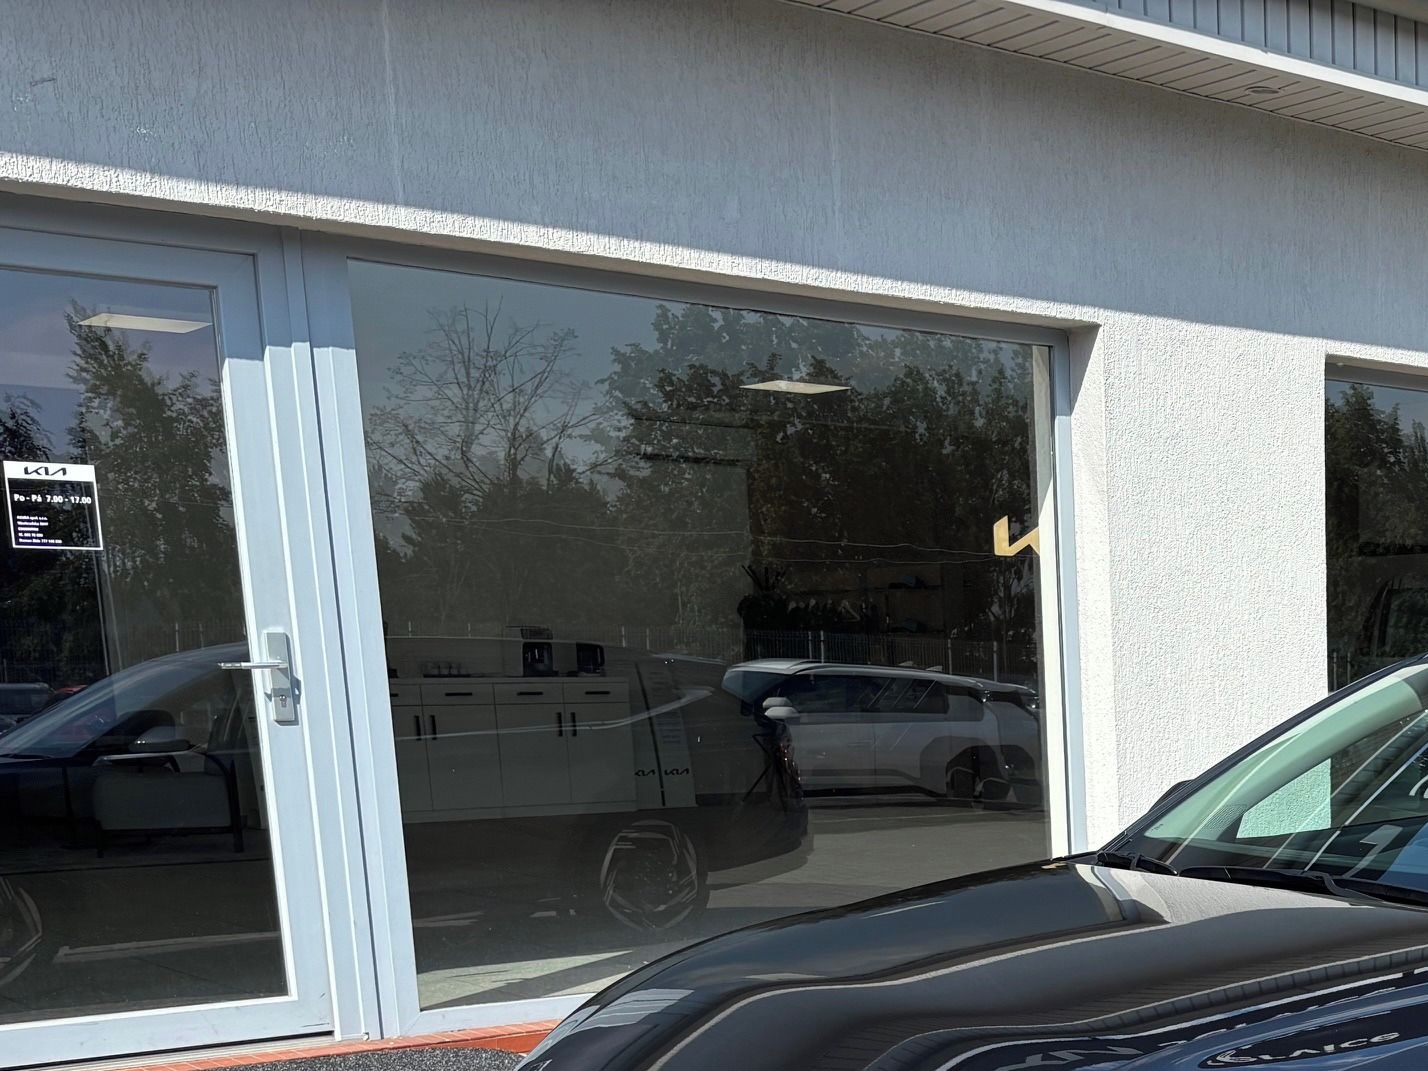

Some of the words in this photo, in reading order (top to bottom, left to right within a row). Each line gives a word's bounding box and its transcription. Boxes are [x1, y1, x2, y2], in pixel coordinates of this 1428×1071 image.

[24, 466, 67, 476] KIA
[13, 493, 25, 502] Po
[45, 495, 63, 503] 7.00
[70, 496, 92, 504] 17.00
